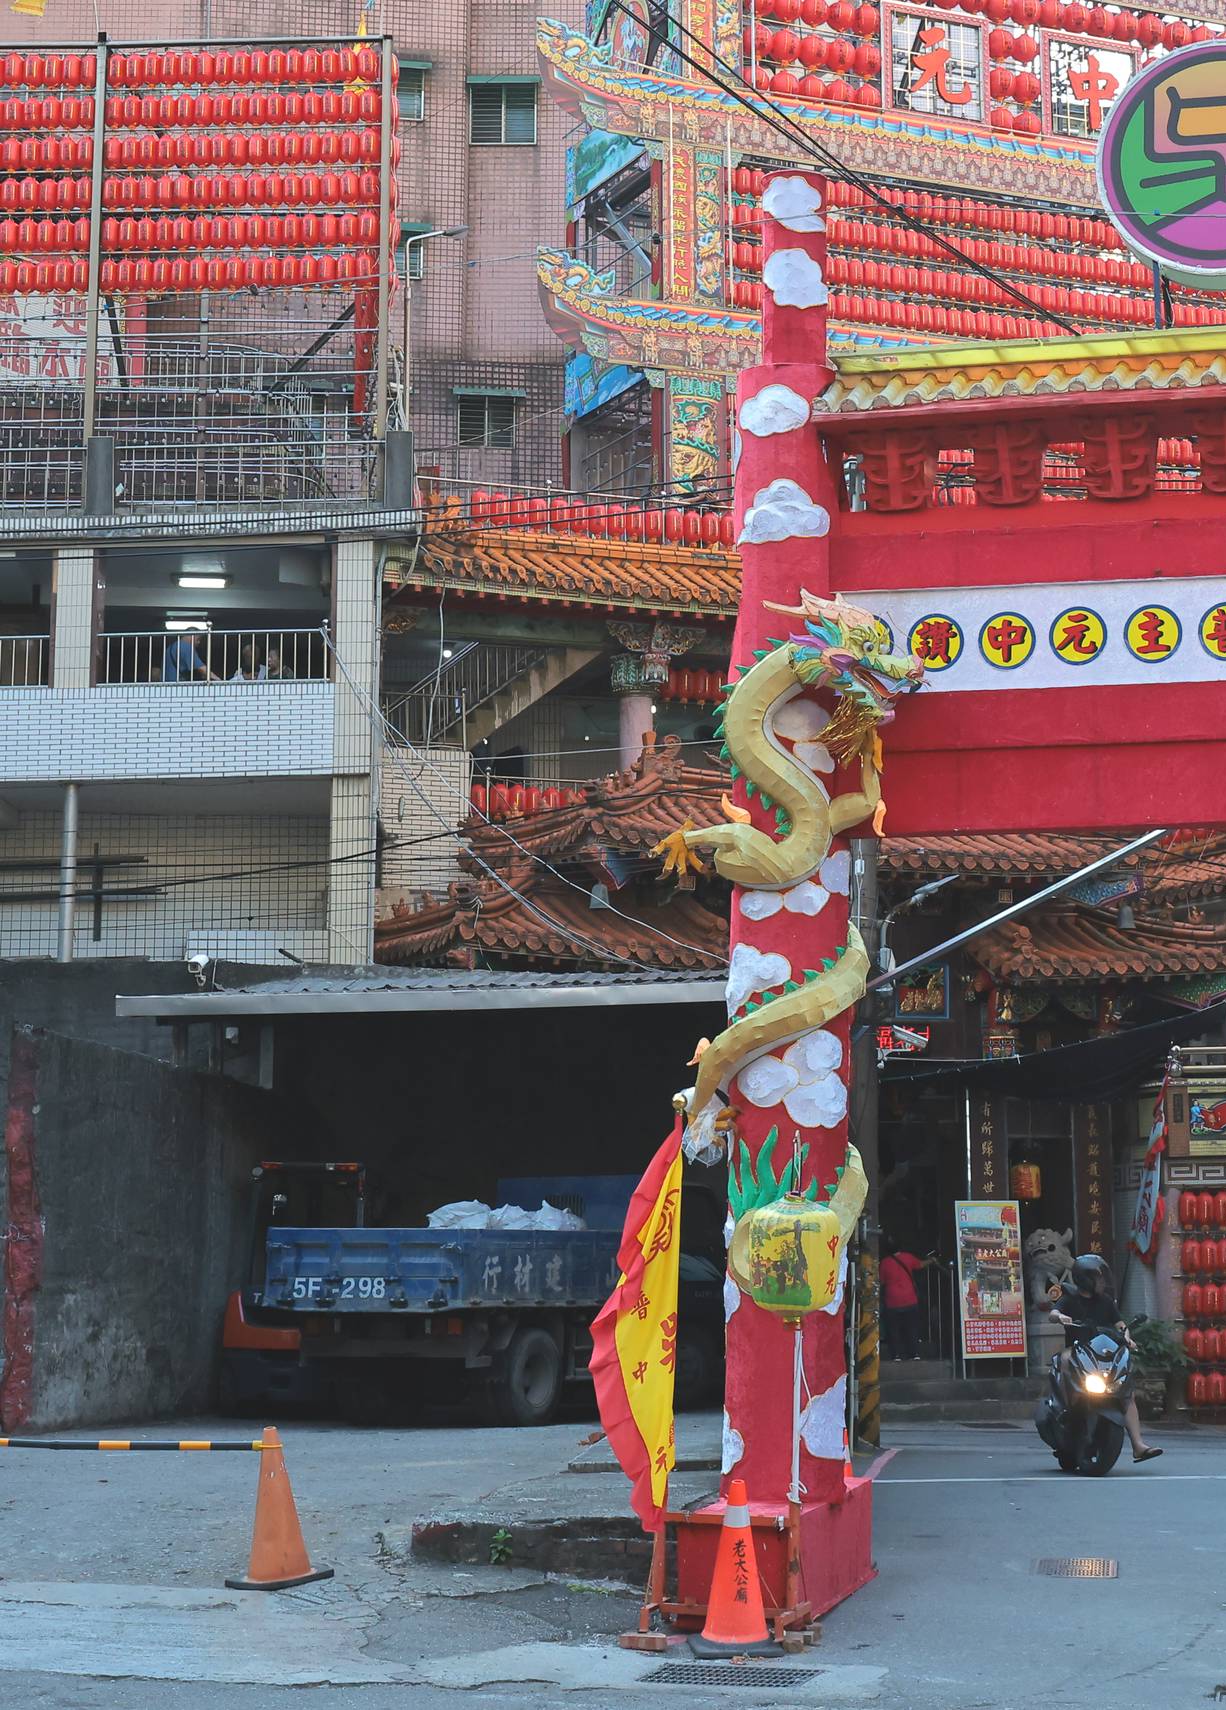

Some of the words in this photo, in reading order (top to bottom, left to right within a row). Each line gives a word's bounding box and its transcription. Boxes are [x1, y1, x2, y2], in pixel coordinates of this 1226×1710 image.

[909, 27, 972, 105] 元
[1067, 54, 1120, 130] 中
[732, 1538, 749, 1605] 老大公廟
